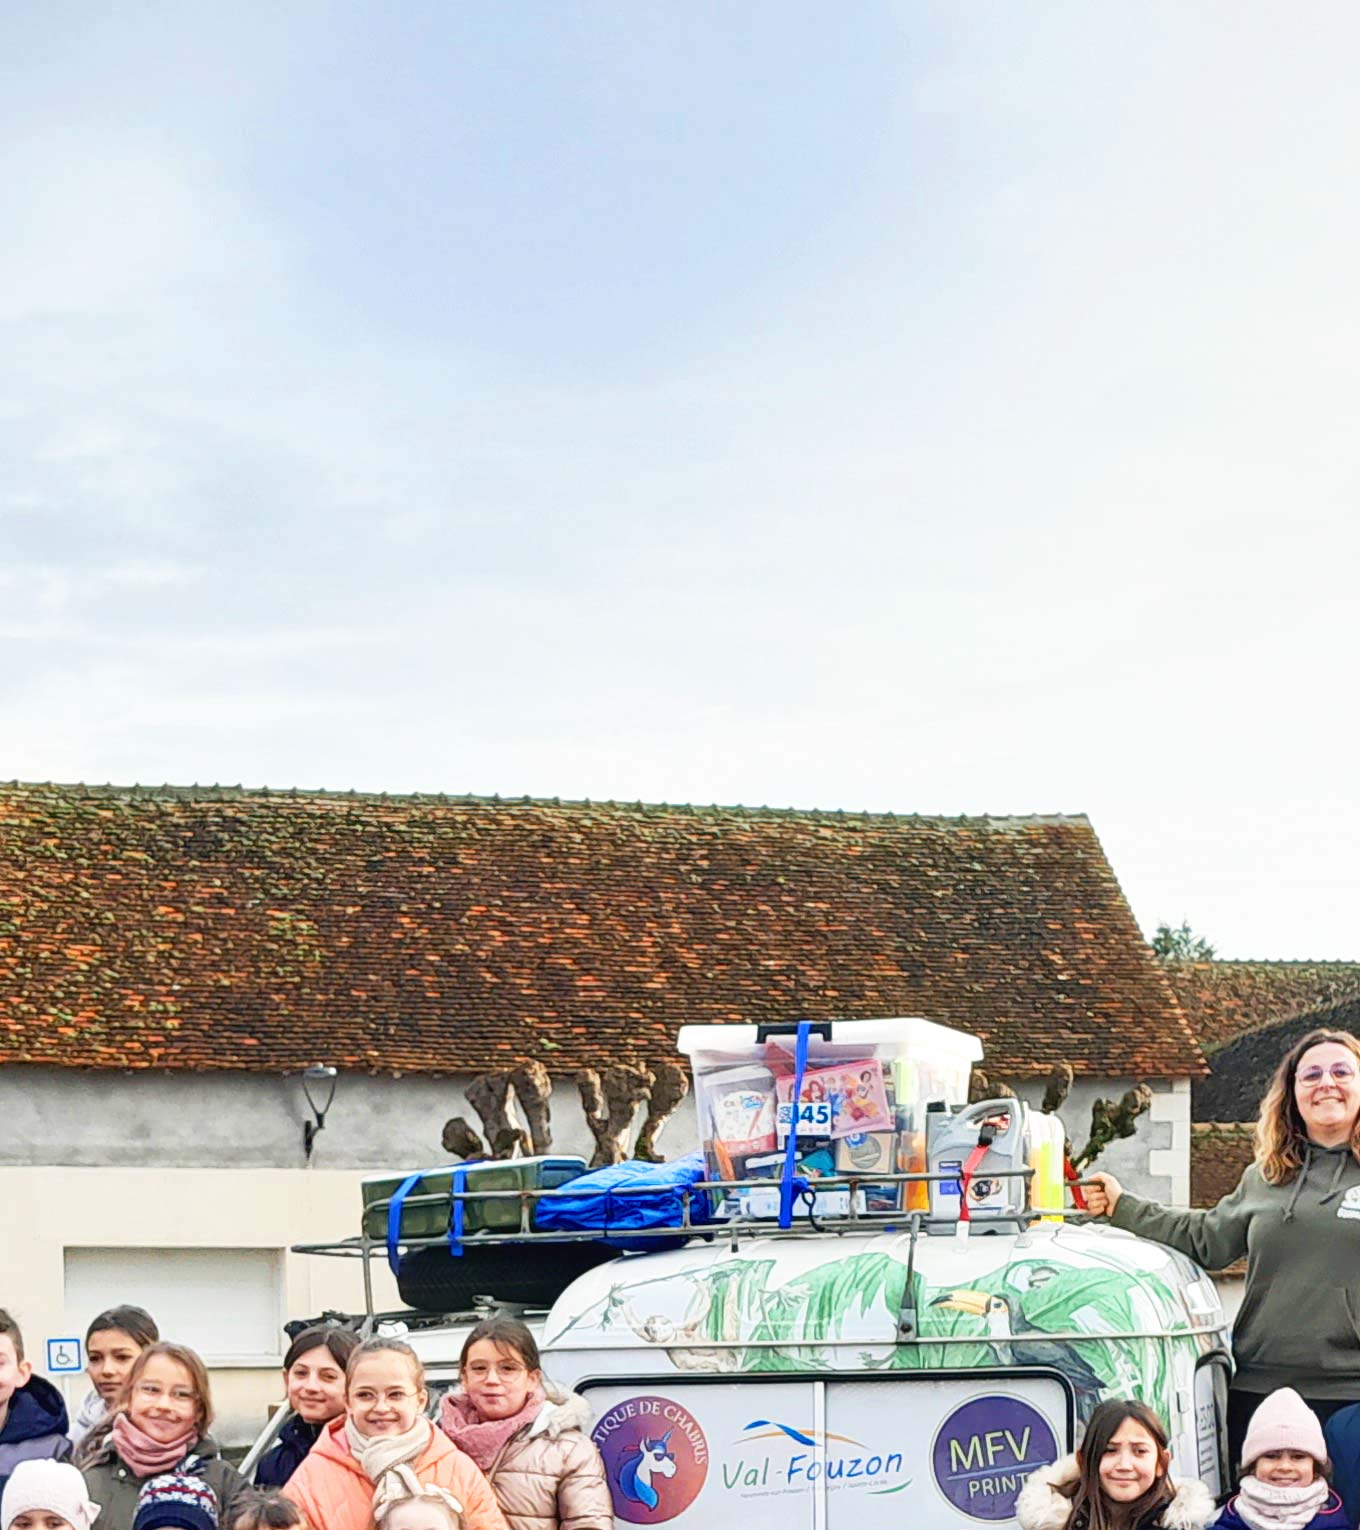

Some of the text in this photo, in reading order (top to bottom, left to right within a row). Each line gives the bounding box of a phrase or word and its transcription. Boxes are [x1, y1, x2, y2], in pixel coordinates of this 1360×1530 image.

[592, 1400, 708, 1465] TIQUE DE CHABRIS
[950, 1426, 1031, 1473] MFV
[968, 1472, 1029, 1499] PRINT
